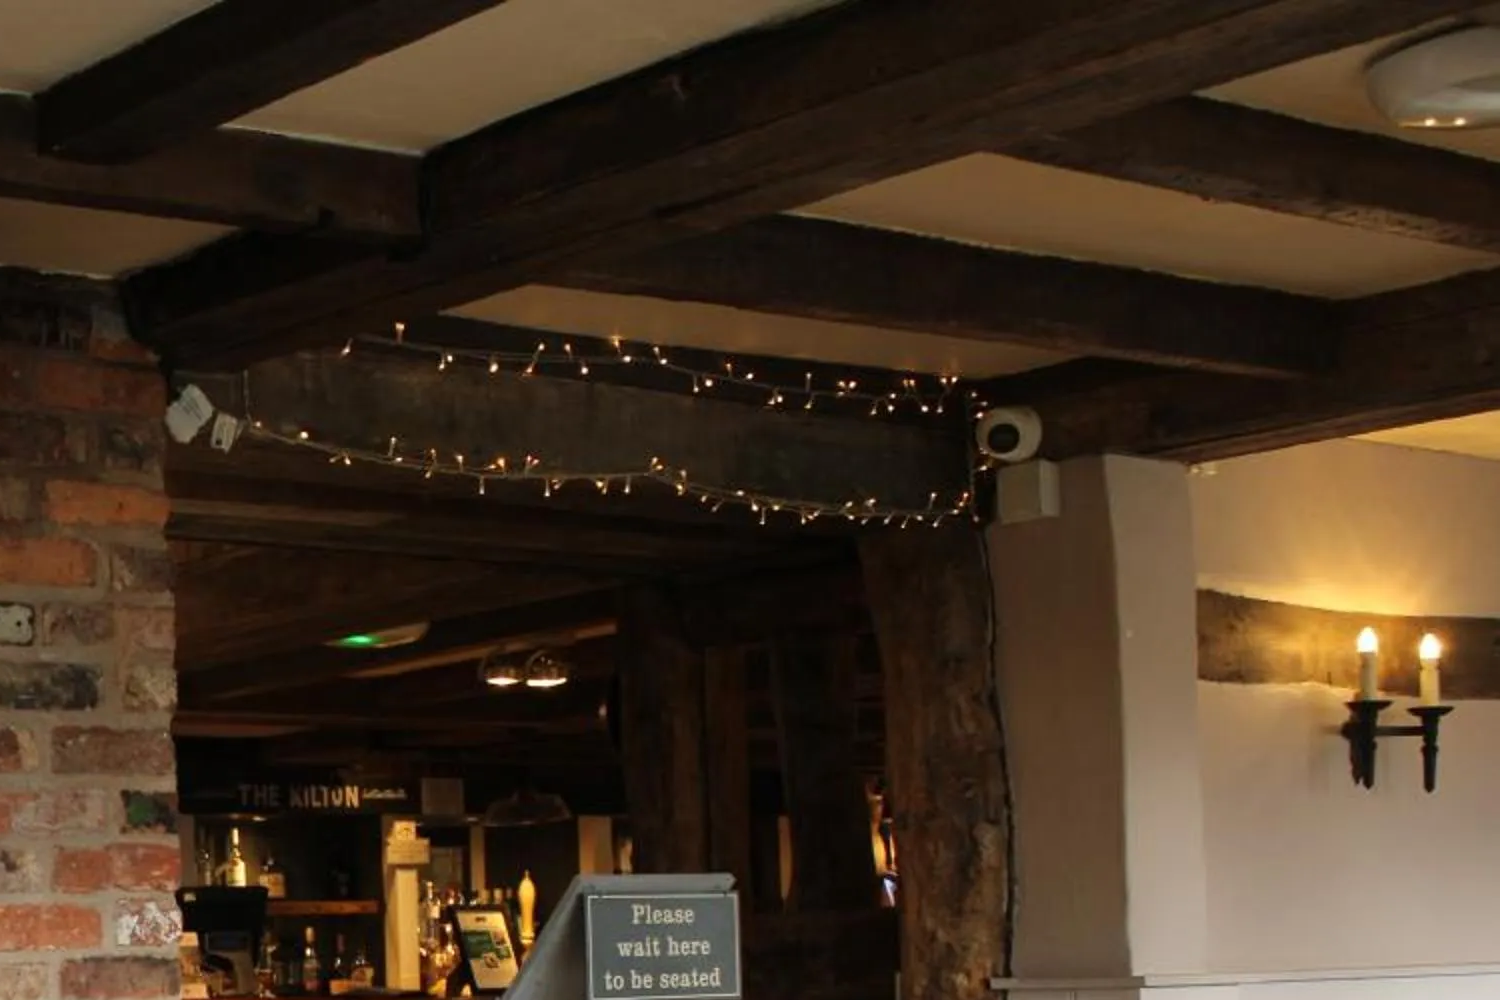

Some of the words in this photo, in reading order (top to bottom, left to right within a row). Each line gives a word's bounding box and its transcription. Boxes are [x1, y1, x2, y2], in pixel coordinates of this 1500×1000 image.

[238, 784, 280, 806] THE
[290, 785, 360, 808] KILTON
[632, 903, 694, 925] Please
[617, 936, 661, 957] wait
[667, 935, 711, 957] here
[604, 971, 625, 990] to
[630, 969, 653, 989] be
[659, 967, 722, 989] seated
